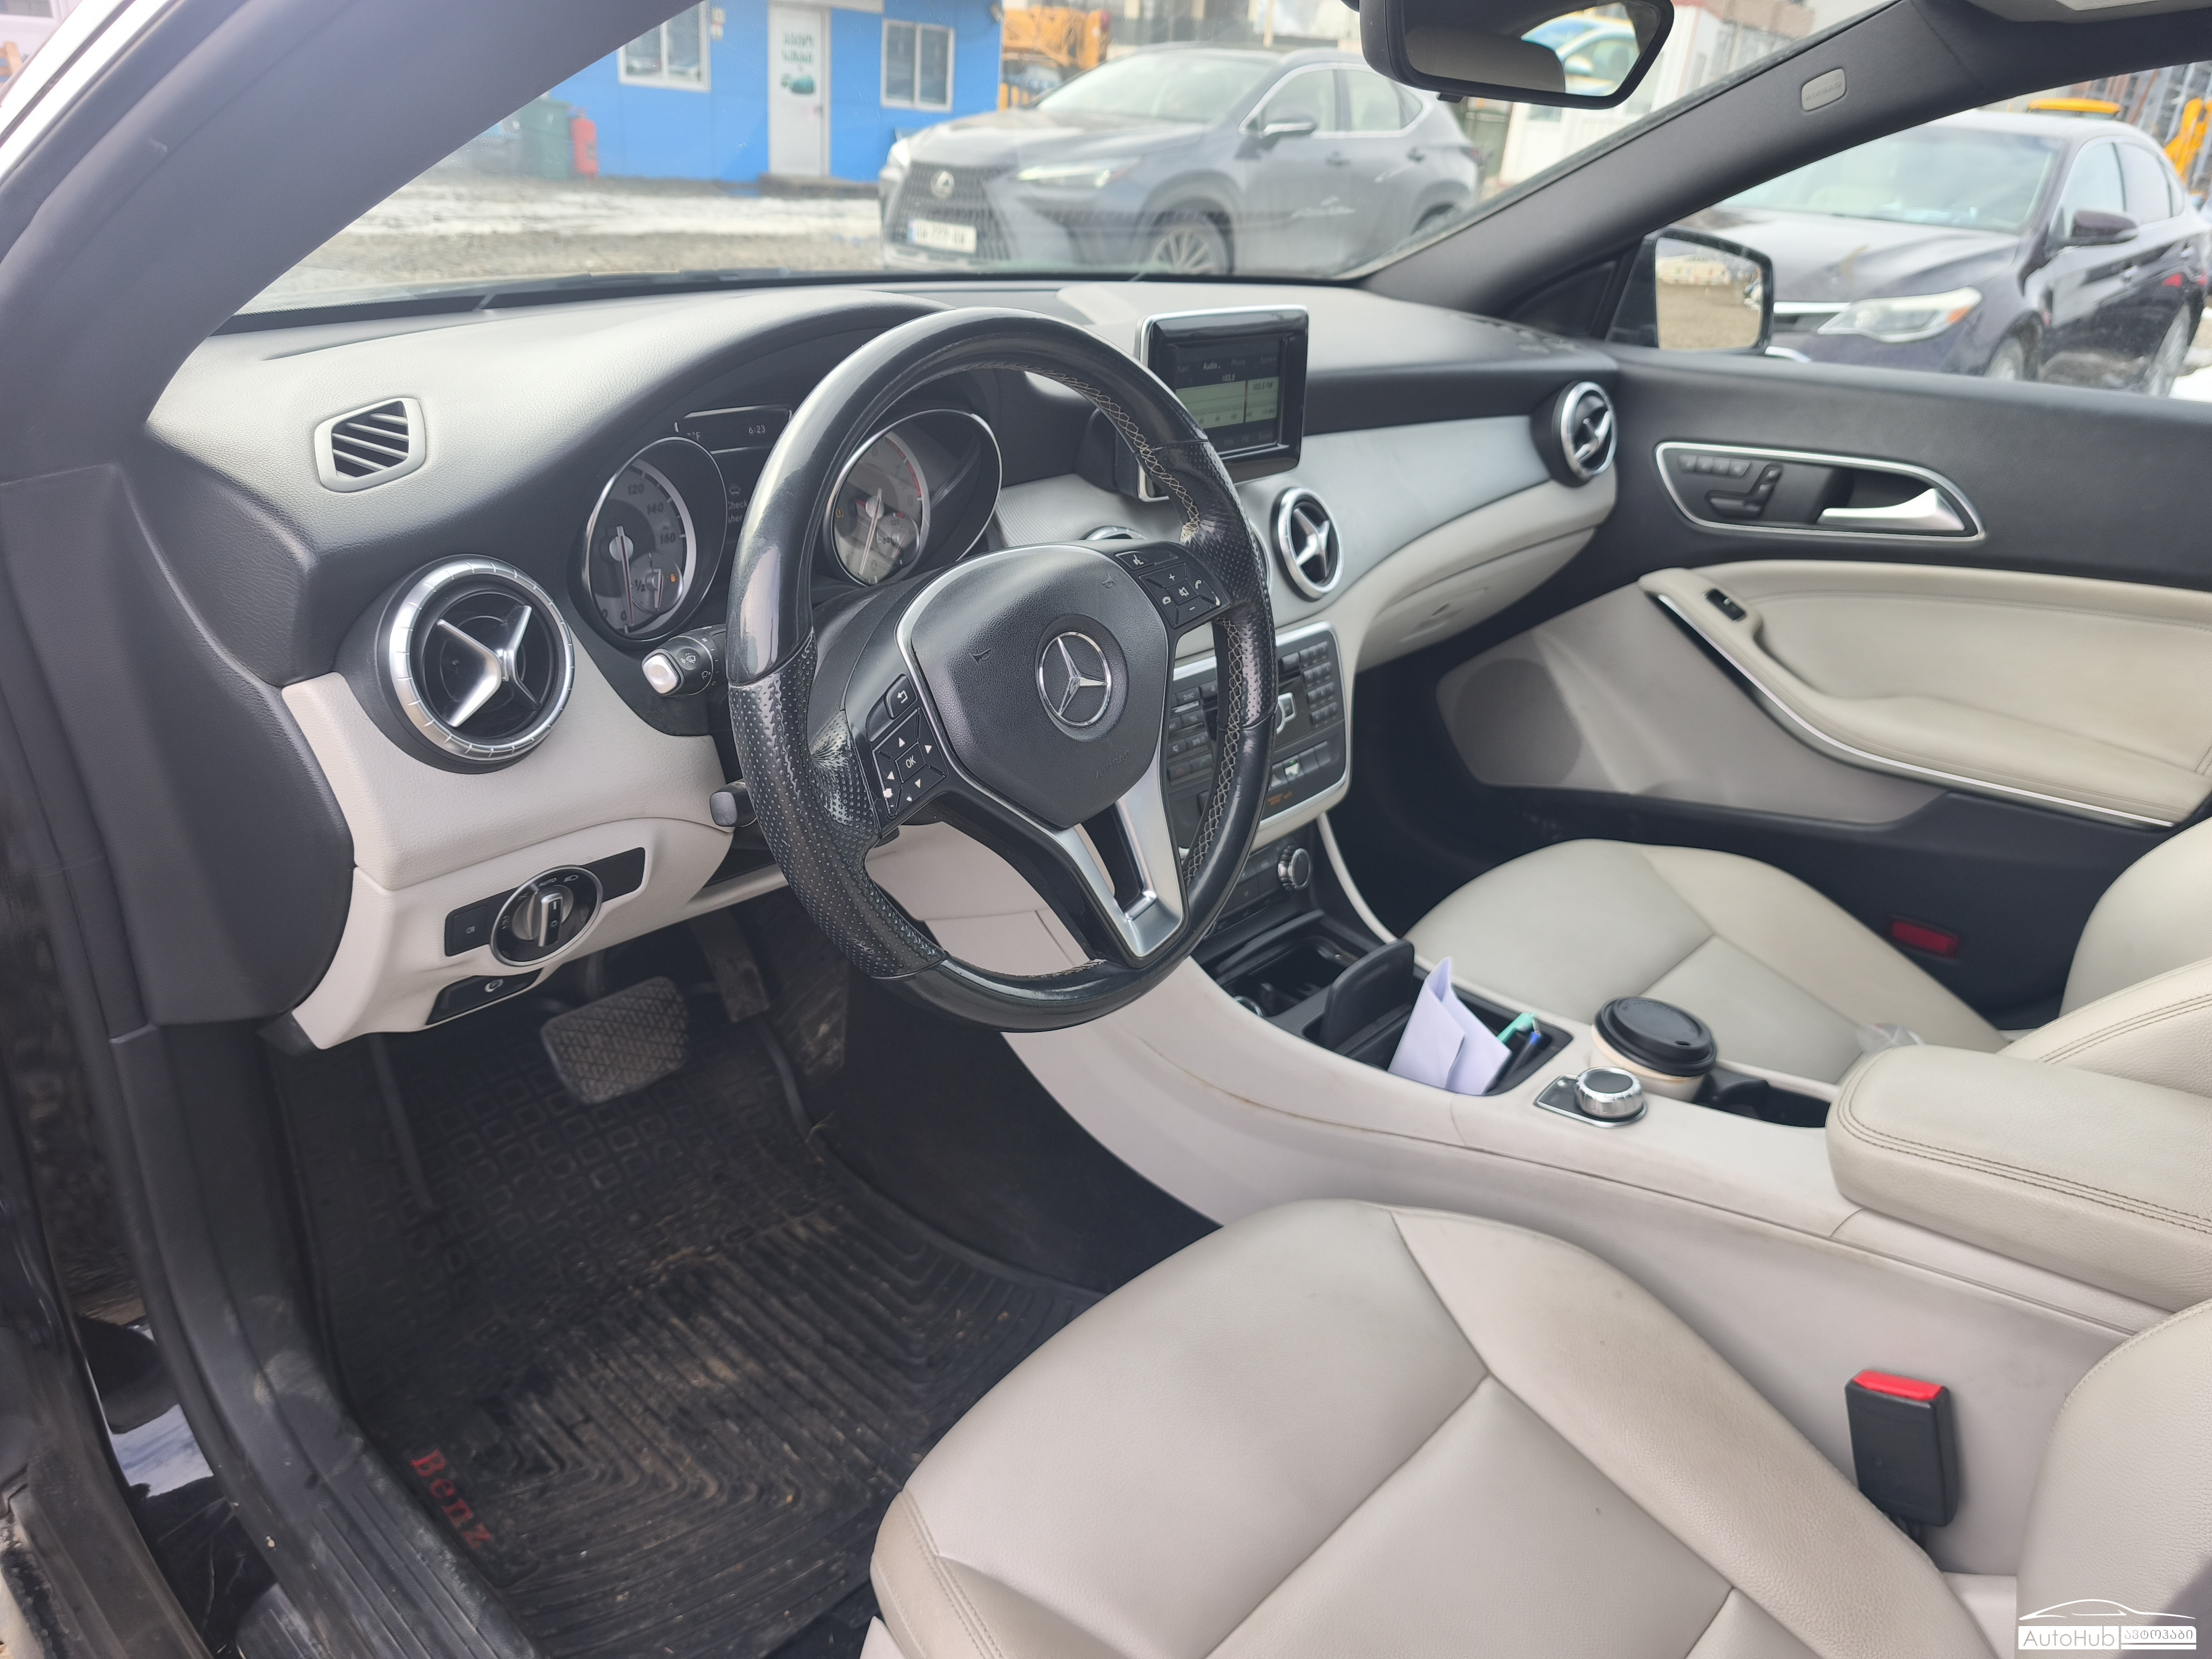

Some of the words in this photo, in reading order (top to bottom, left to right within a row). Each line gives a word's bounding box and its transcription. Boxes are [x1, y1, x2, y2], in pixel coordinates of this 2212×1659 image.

[1203, 361, 1218, 370] Audio
[748, 424, 766, 435] 6:23
[1183, 692, 1195, 700] DISC
[906, 755, 916, 768] OK
[1096, 749, 1131, 778] ARBAG
[410, 1448, 493, 1549] Benz
